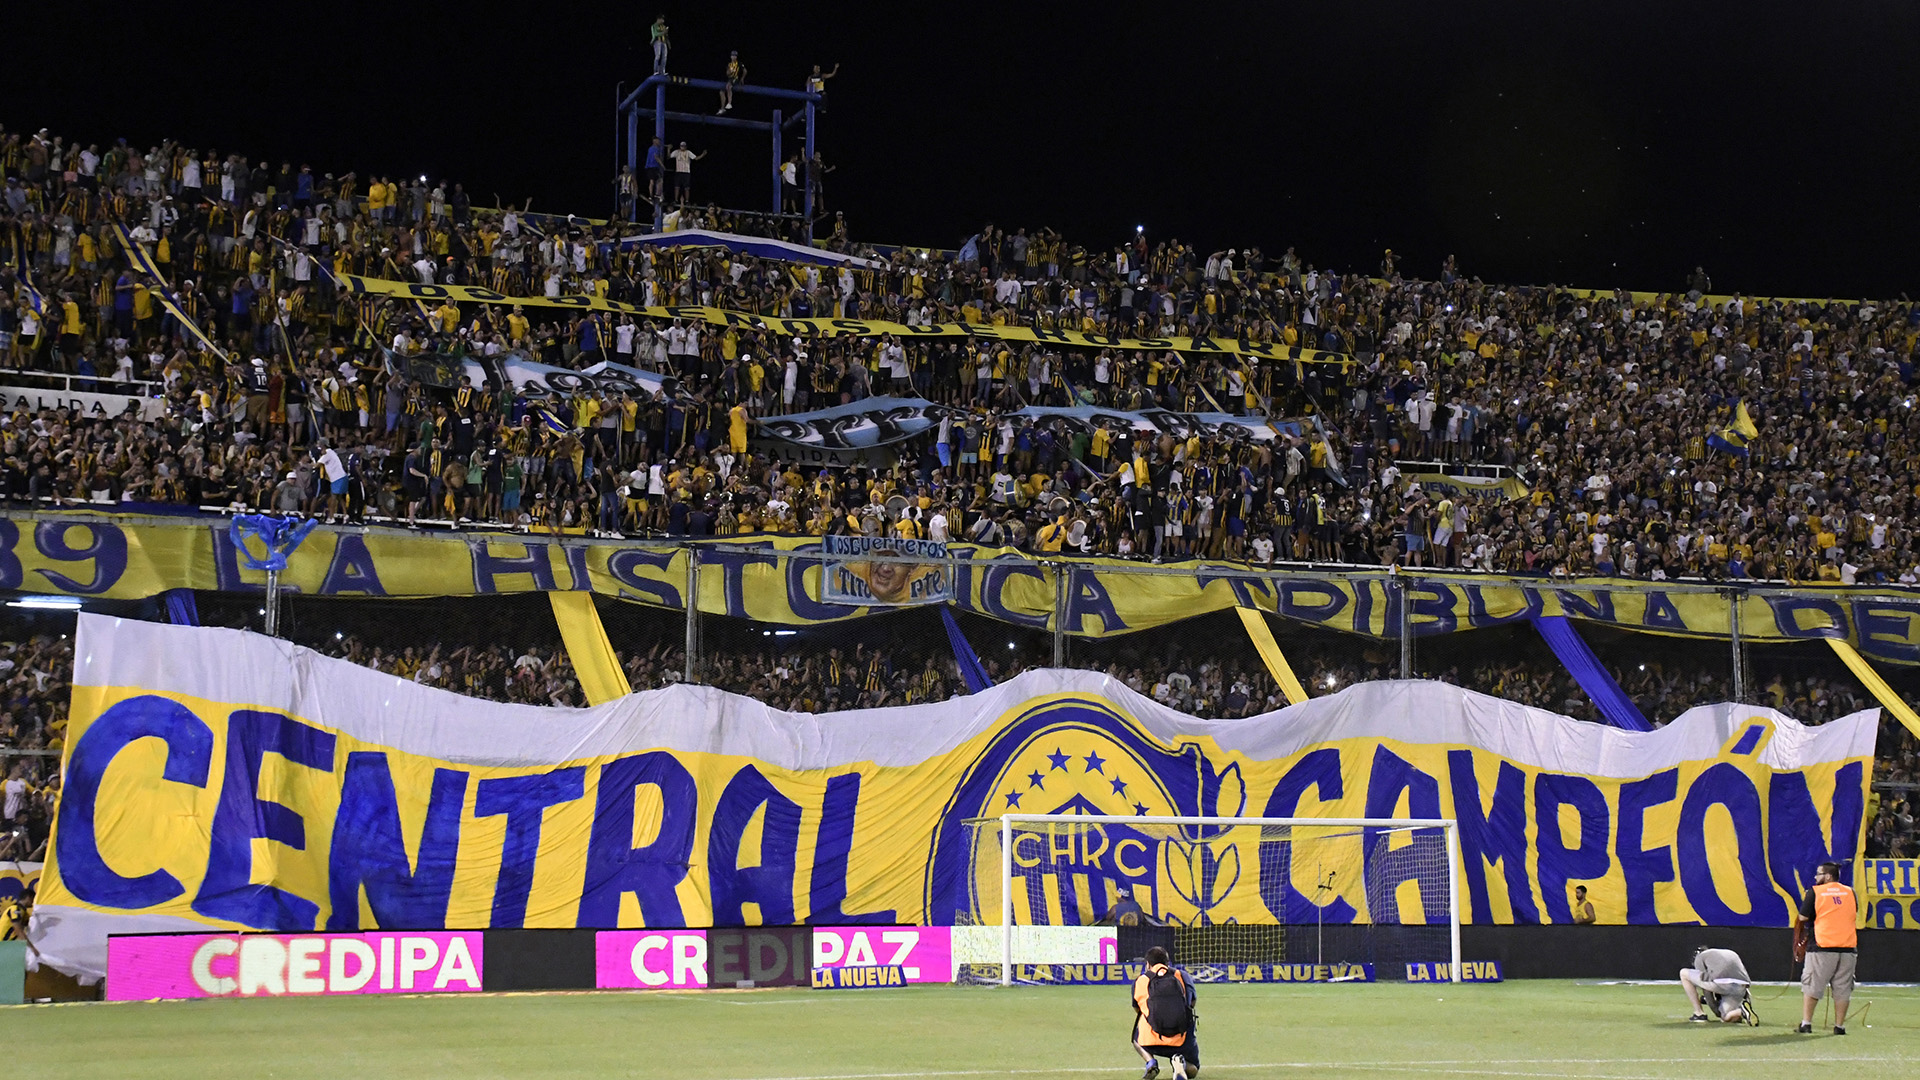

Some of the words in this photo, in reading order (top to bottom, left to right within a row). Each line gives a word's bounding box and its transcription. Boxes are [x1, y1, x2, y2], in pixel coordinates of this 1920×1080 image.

[0, 518, 128, 594] 9
[210, 526, 389, 595] LA
[464, 539, 1132, 633] HISTOICA
[1762, 594, 1920, 658] DE
[57, 694, 918, 931] CENTRAL
[1259, 724, 1865, 927] CAMPEÓN
[1832, 896, 1842, 905] 16
[192, 937, 482, 996] CREDIPA
[630, 930, 920, 987] CREDIPAZ
[811, 967, 835, 988] LA
[839, 965, 901, 987] NUEVA
[1016, 963, 1053, 981] LA
[1064, 964, 1147, 982] NUEV
[1227, 964, 1264, 981] LA
[1272, 964, 1367, 981] NUEVA
[1406, 963, 1430, 981] LA
